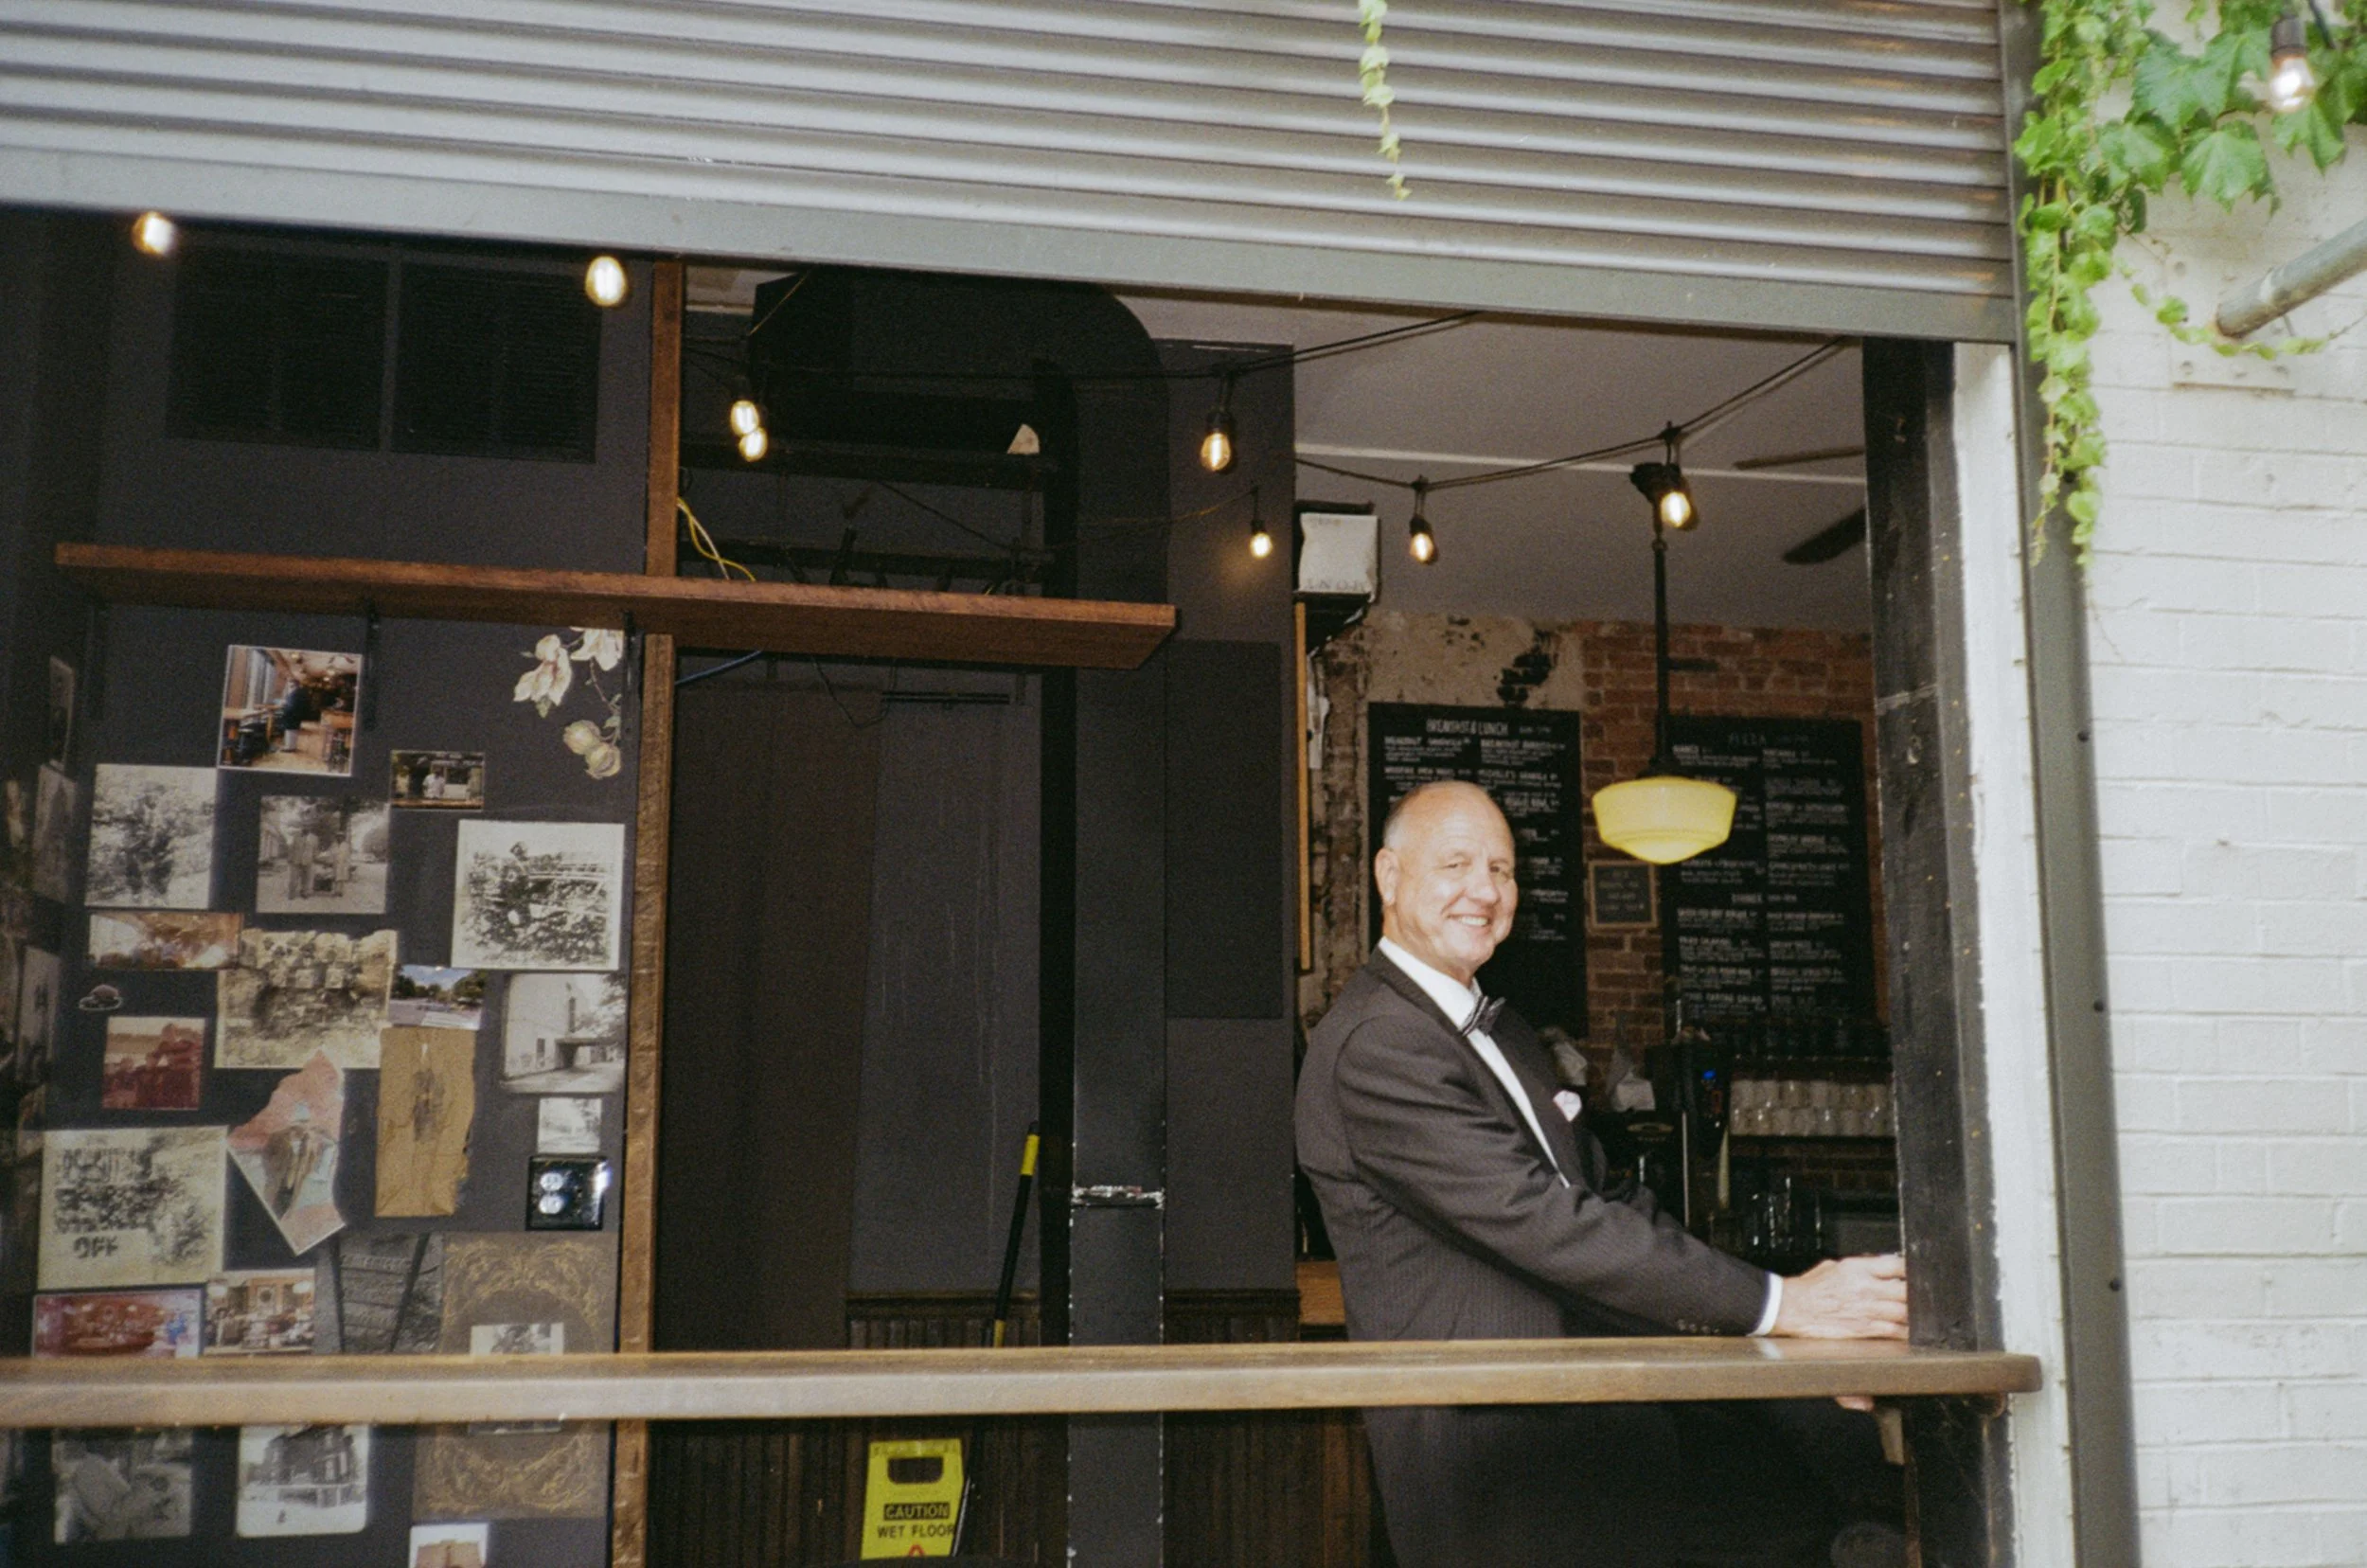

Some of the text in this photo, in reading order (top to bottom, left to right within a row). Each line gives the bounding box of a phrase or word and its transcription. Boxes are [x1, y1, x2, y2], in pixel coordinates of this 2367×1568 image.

[885, 1505, 948, 1519] CAUTION
[877, 1523, 955, 1539] WET FLOOR
